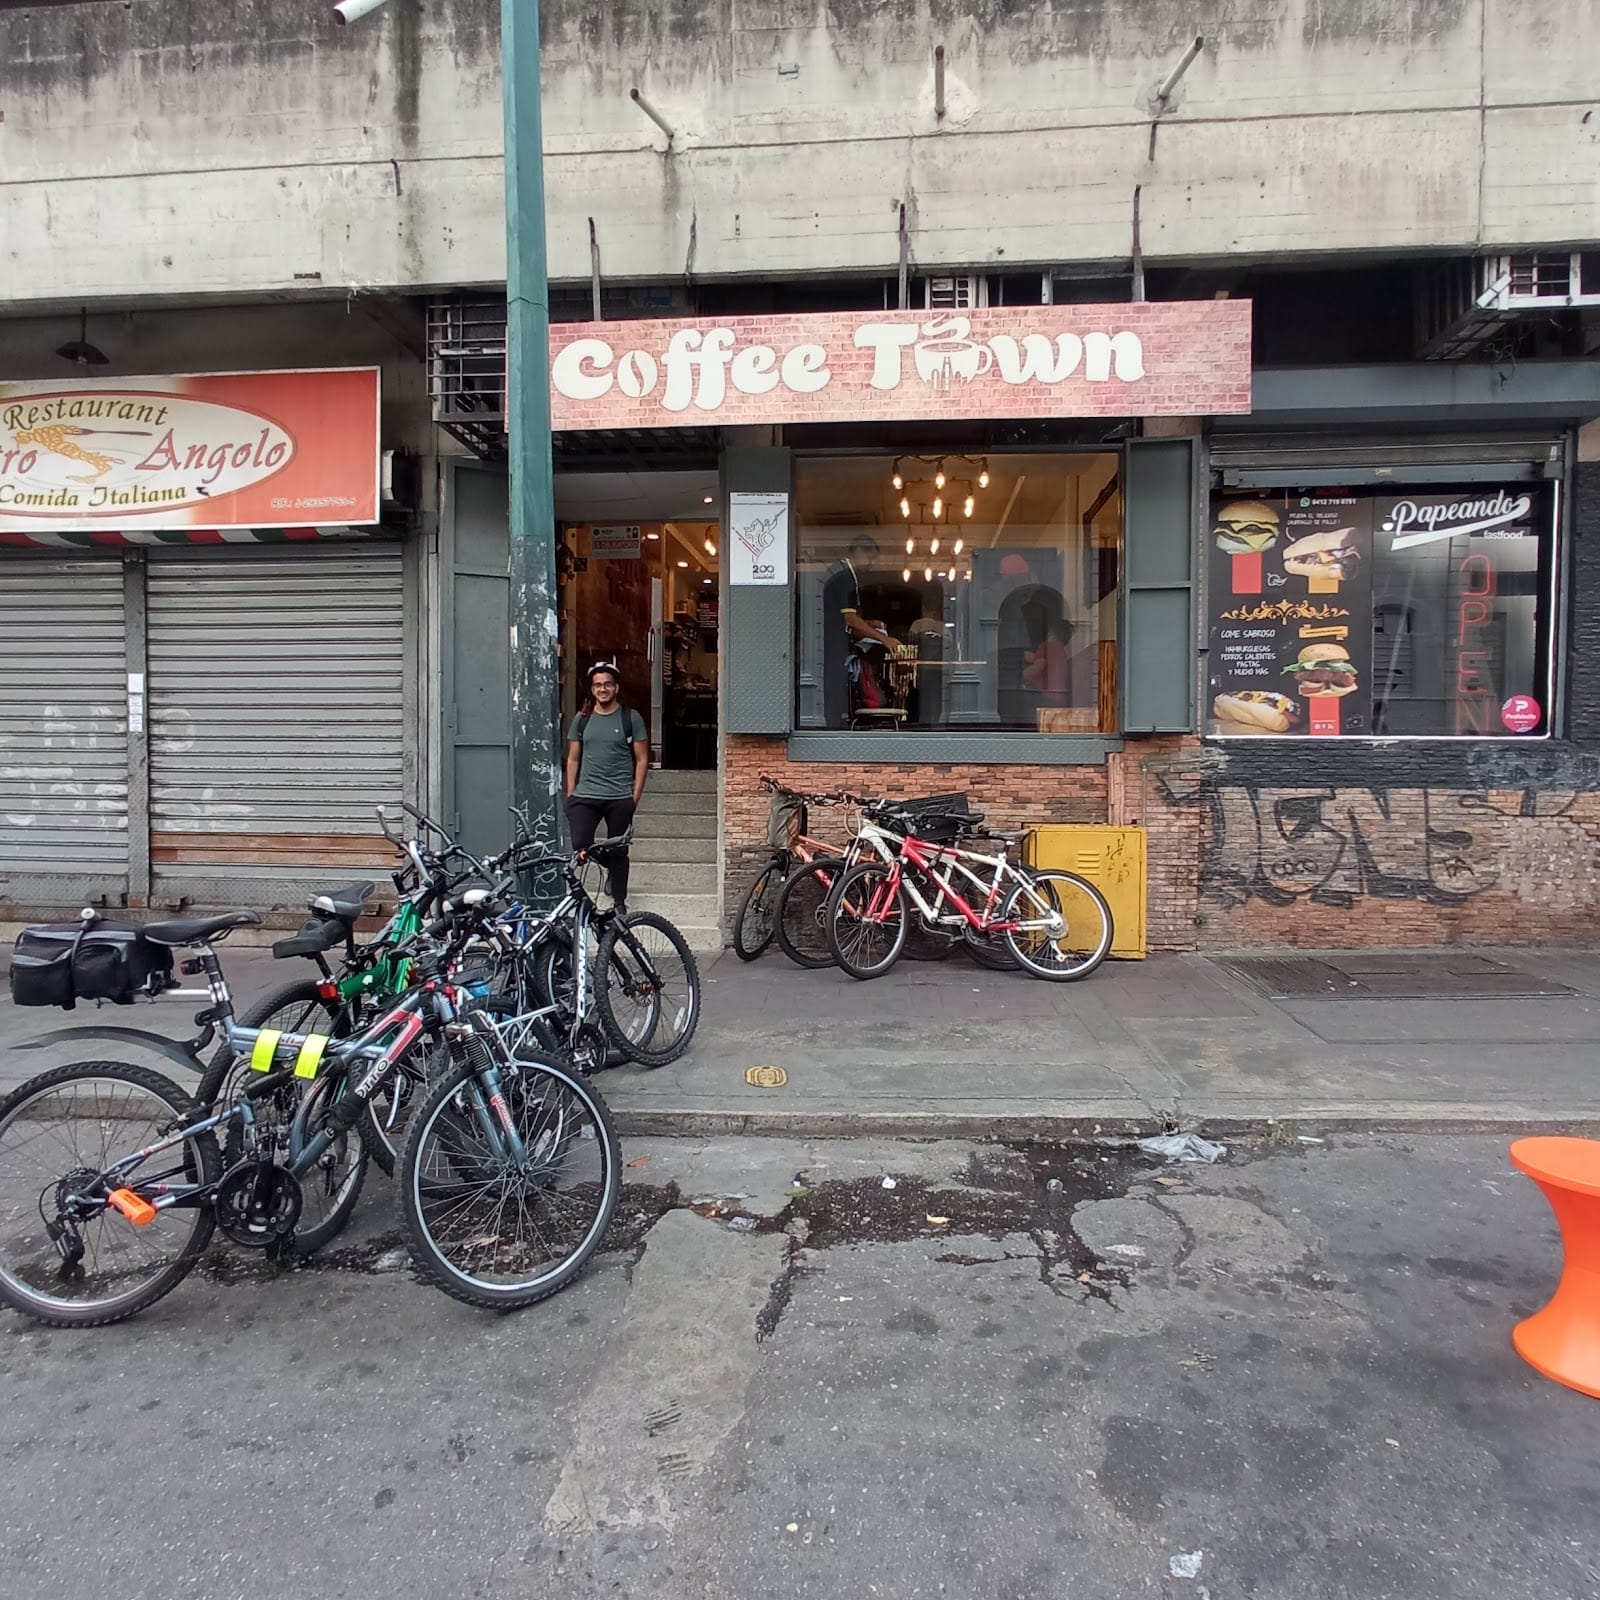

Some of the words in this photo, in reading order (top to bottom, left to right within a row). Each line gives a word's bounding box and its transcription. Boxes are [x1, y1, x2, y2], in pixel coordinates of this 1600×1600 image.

[552, 327, 831, 411] Coffee
[3, 399, 168, 431] Restaurant
[0, 445, 38, 475] ro
[135, 427, 286, 484] Angolo
[0, 484, 78, 506] Comida
[1392, 489, 1524, 536] Papeando
[1243, 629, 1276, 638] SABROSO
[1456, 554, 1491, 736] OPEN
